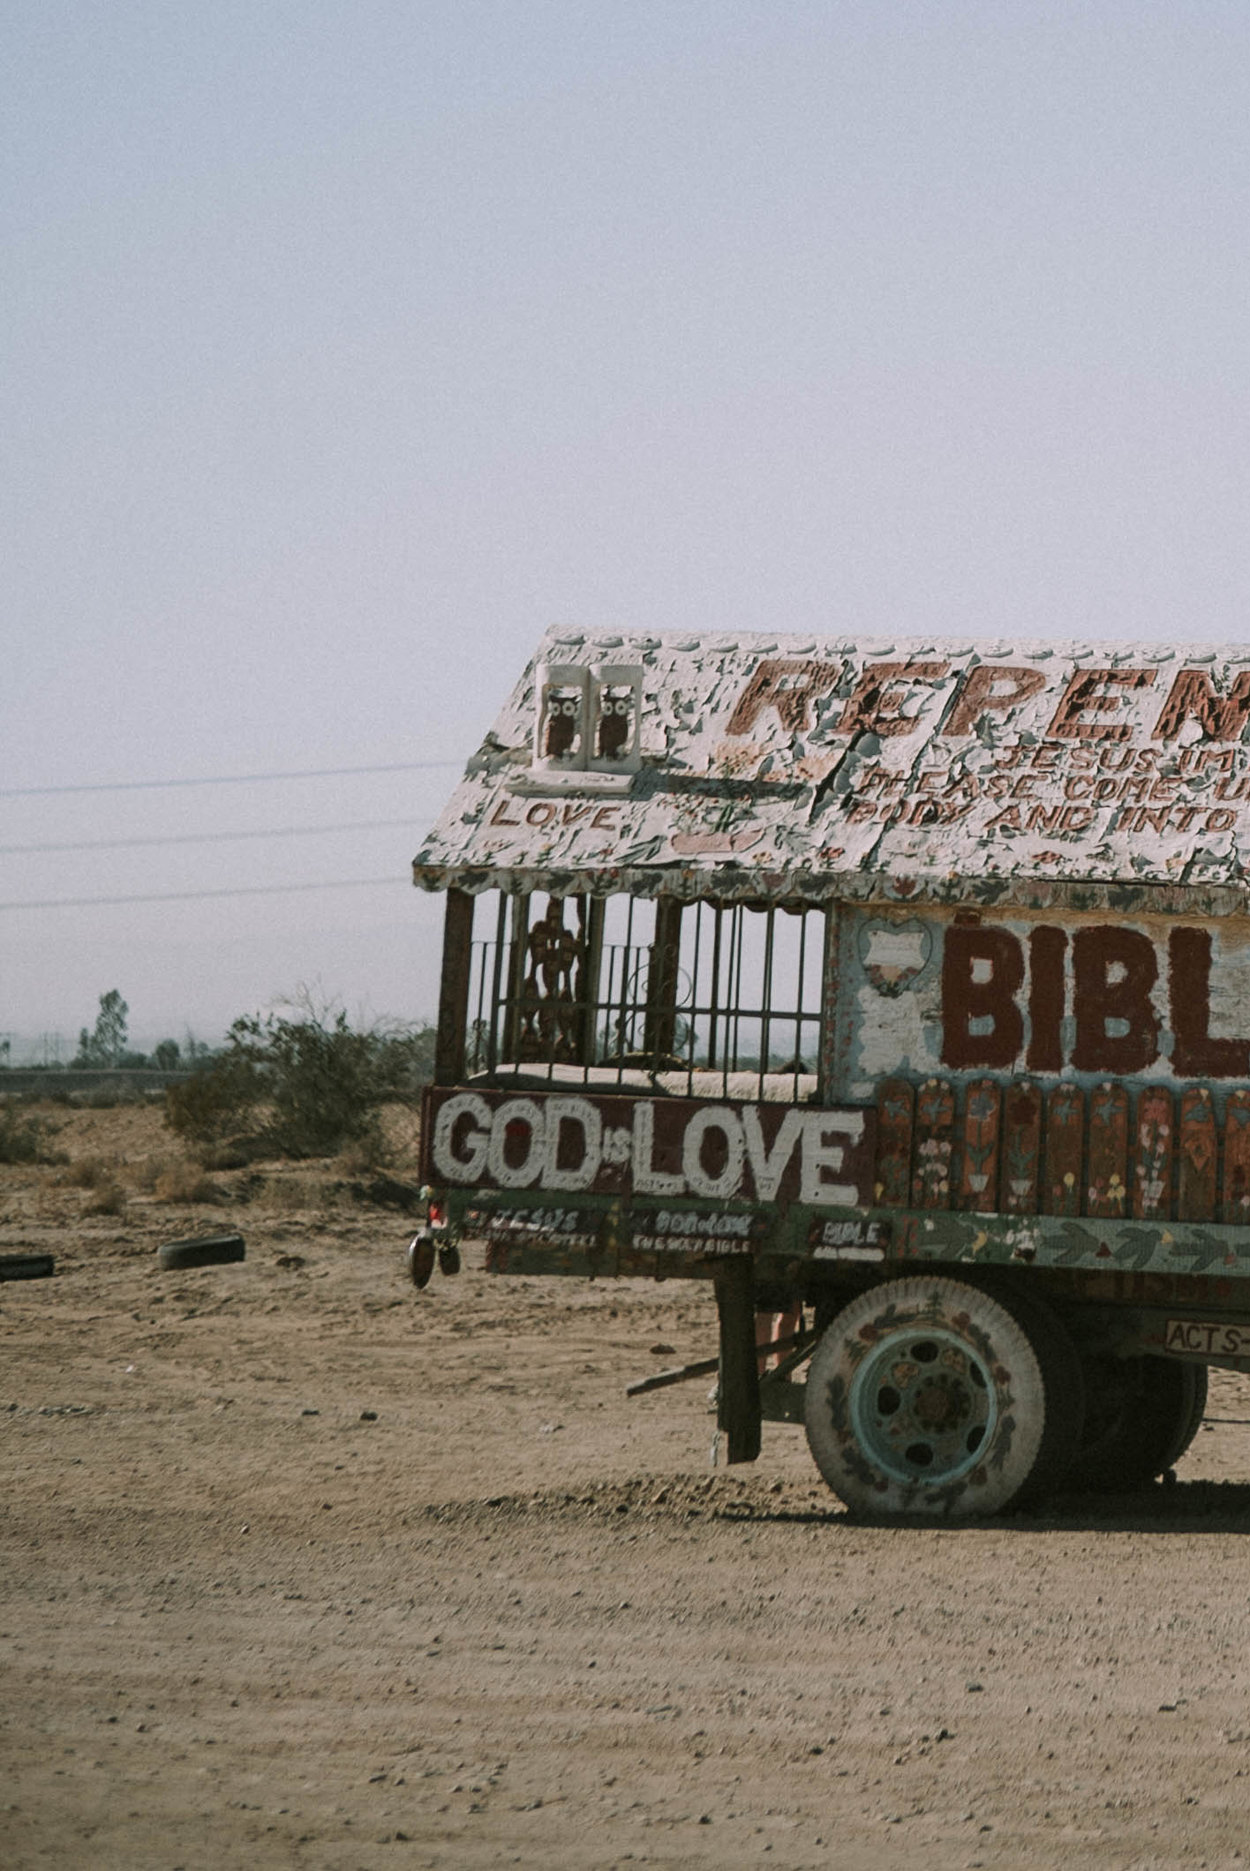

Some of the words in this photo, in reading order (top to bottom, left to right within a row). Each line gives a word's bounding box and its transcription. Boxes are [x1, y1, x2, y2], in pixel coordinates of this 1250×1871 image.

[995, 745, 1163, 773] JESUS
[858, 768, 1049, 799] PLEASE
[1064, 776, 1184, 803] COME
[490, 800, 621, 831] LOVE
[846, 799, 977, 827] BODY
[984, 805, 1095, 829] AND
[1115, 806, 1237, 833] INTO
[433, 1093, 601, 1191] GOD
[632, 1101, 866, 1206] LOVE
